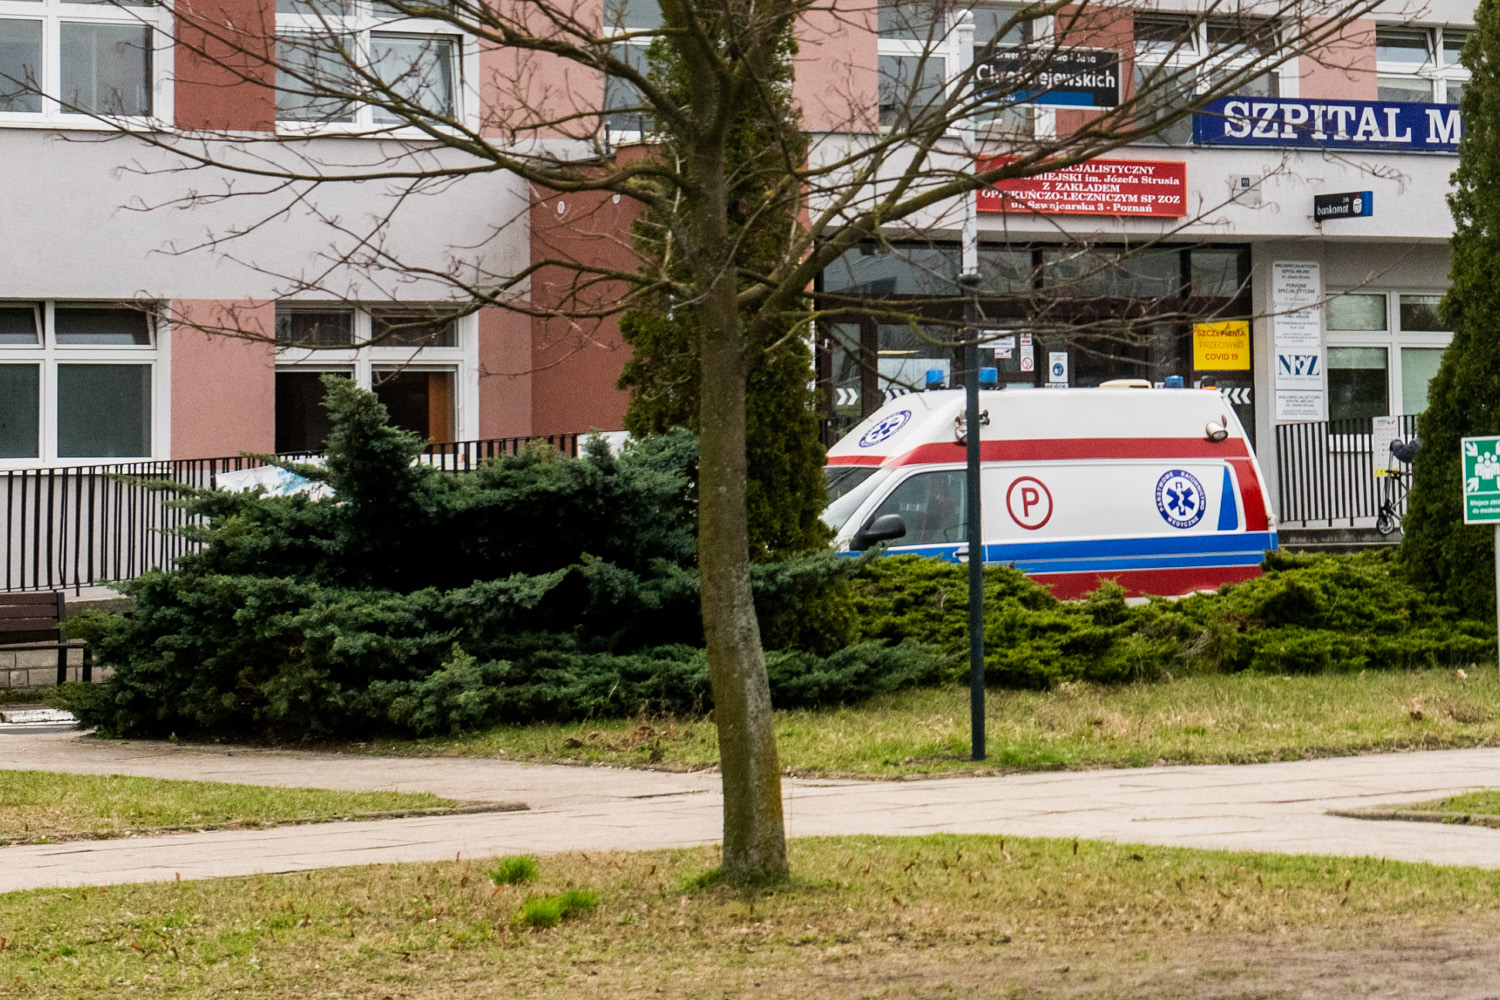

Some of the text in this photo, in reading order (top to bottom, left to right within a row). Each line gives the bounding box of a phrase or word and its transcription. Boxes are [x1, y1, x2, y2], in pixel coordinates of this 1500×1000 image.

[1223, 100, 1413, 143] SZPITAL
[1033, 171, 1083, 182] MIEJSKI
[1085, 173, 1102, 182] im.
[1104, 174, 1139, 183] Józefa
[1141, 175, 1180, 185] Strusia
[1042, 181, 1120, 193] Z ZAKŁADEM
[1140, 194, 1156, 203] SP
[1158, 195, 1181, 204] ZOZ
[1097, 203, 1104, 211] 3
[1113, 203, 1153, 212] Poznań
[1317, 203, 1349, 215] bankomat
[1197, 329, 1246, 337] SZCZEPIENIA
[1200, 341, 1244, 349] PRZECIWKO
[1278, 354, 1320, 376] NFZ
[1022, 487, 1039, 517] P
